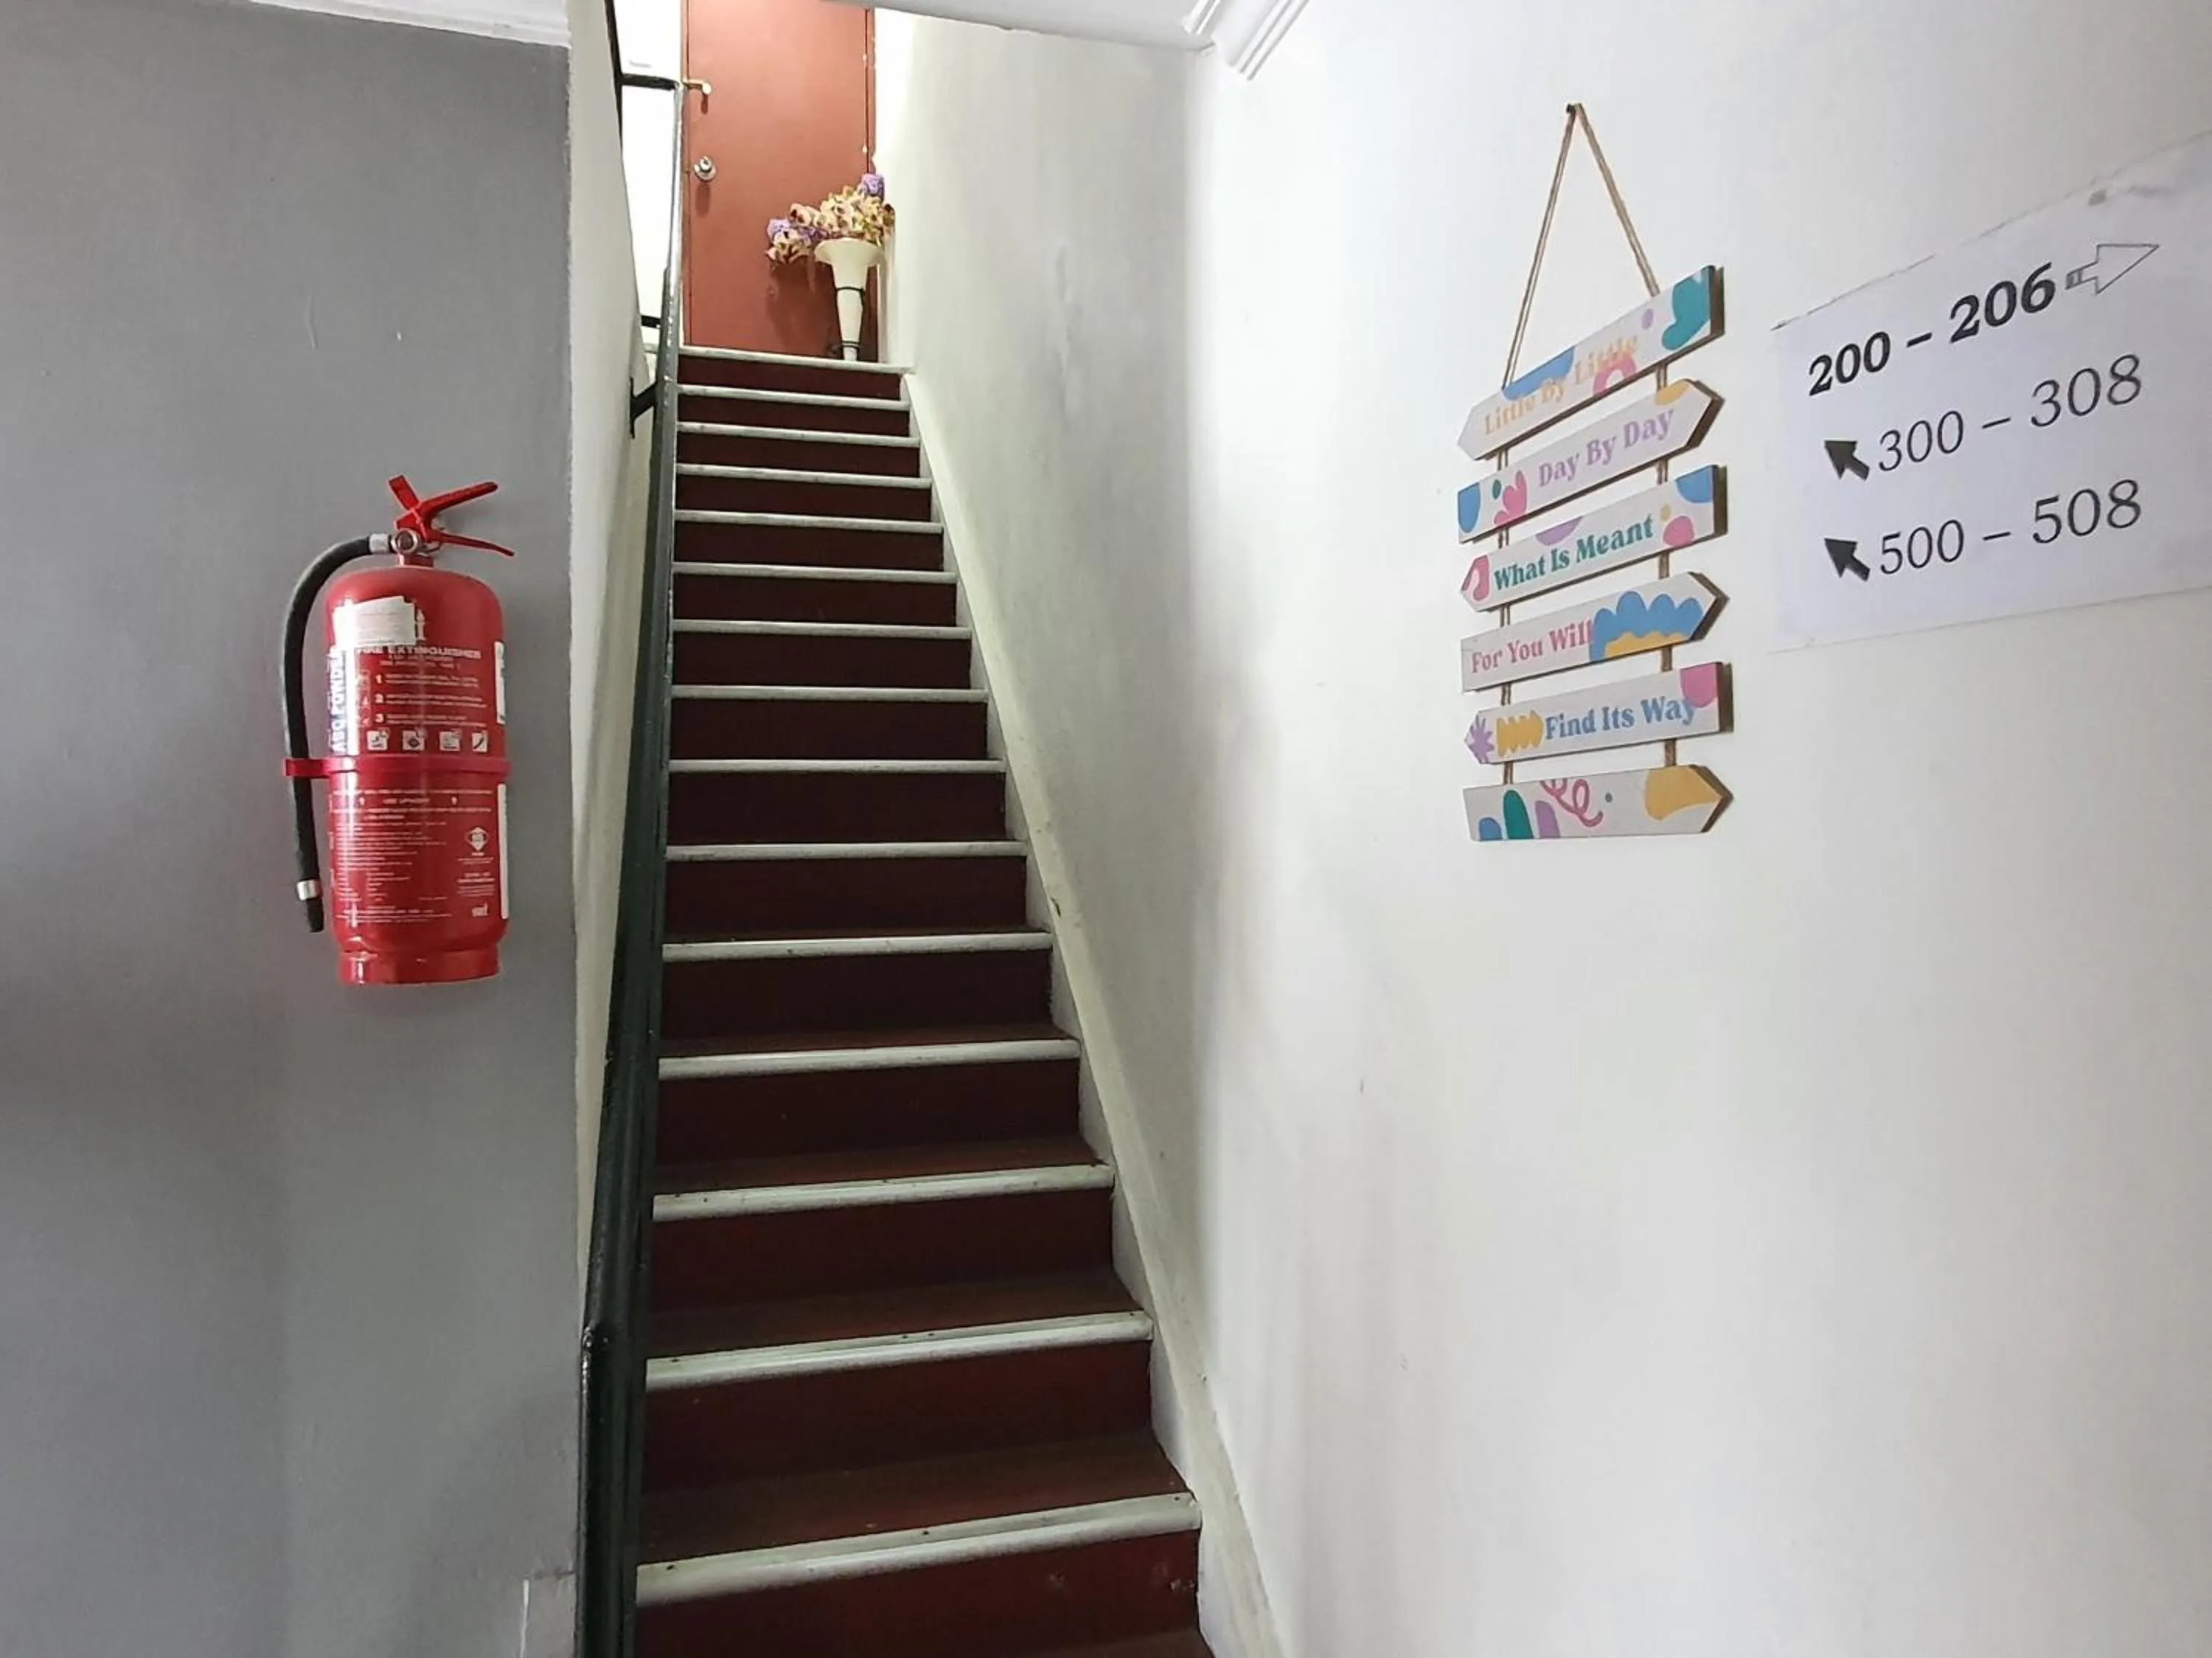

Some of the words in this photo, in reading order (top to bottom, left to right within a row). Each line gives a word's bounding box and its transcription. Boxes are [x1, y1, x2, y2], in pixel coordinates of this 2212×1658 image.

[1809, 331, 1891, 396] 200
[1949, 262, 2056, 344] 206
[1484, 395, 1535, 436] Little
[1541, 378, 1567, 405] By
[1574, 334, 1638, 385] Little
[1878, 410, 1964, 472] 300
[2030, 354, 2142, 427] 308
[1539, 453, 1580, 487] Day
[1586, 436, 1616, 466] By
[1623, 409, 1674, 448] Day
[1494, 555, 1545, 591] What
[1551, 548, 1571, 572] Is
[1576, 513, 1653, 563] Meant
[1879, 518, 1964, 575] 500
[2031, 479, 2142, 544] 508
[1472, 649, 1503, 673] For
[1507, 639, 1543, 663] You
[1548, 618, 1593, 651] Will
[1545, 709, 1596, 740] Find
[1601, 706, 1635, 731] Its
[1640, 696, 1695, 726] Way
